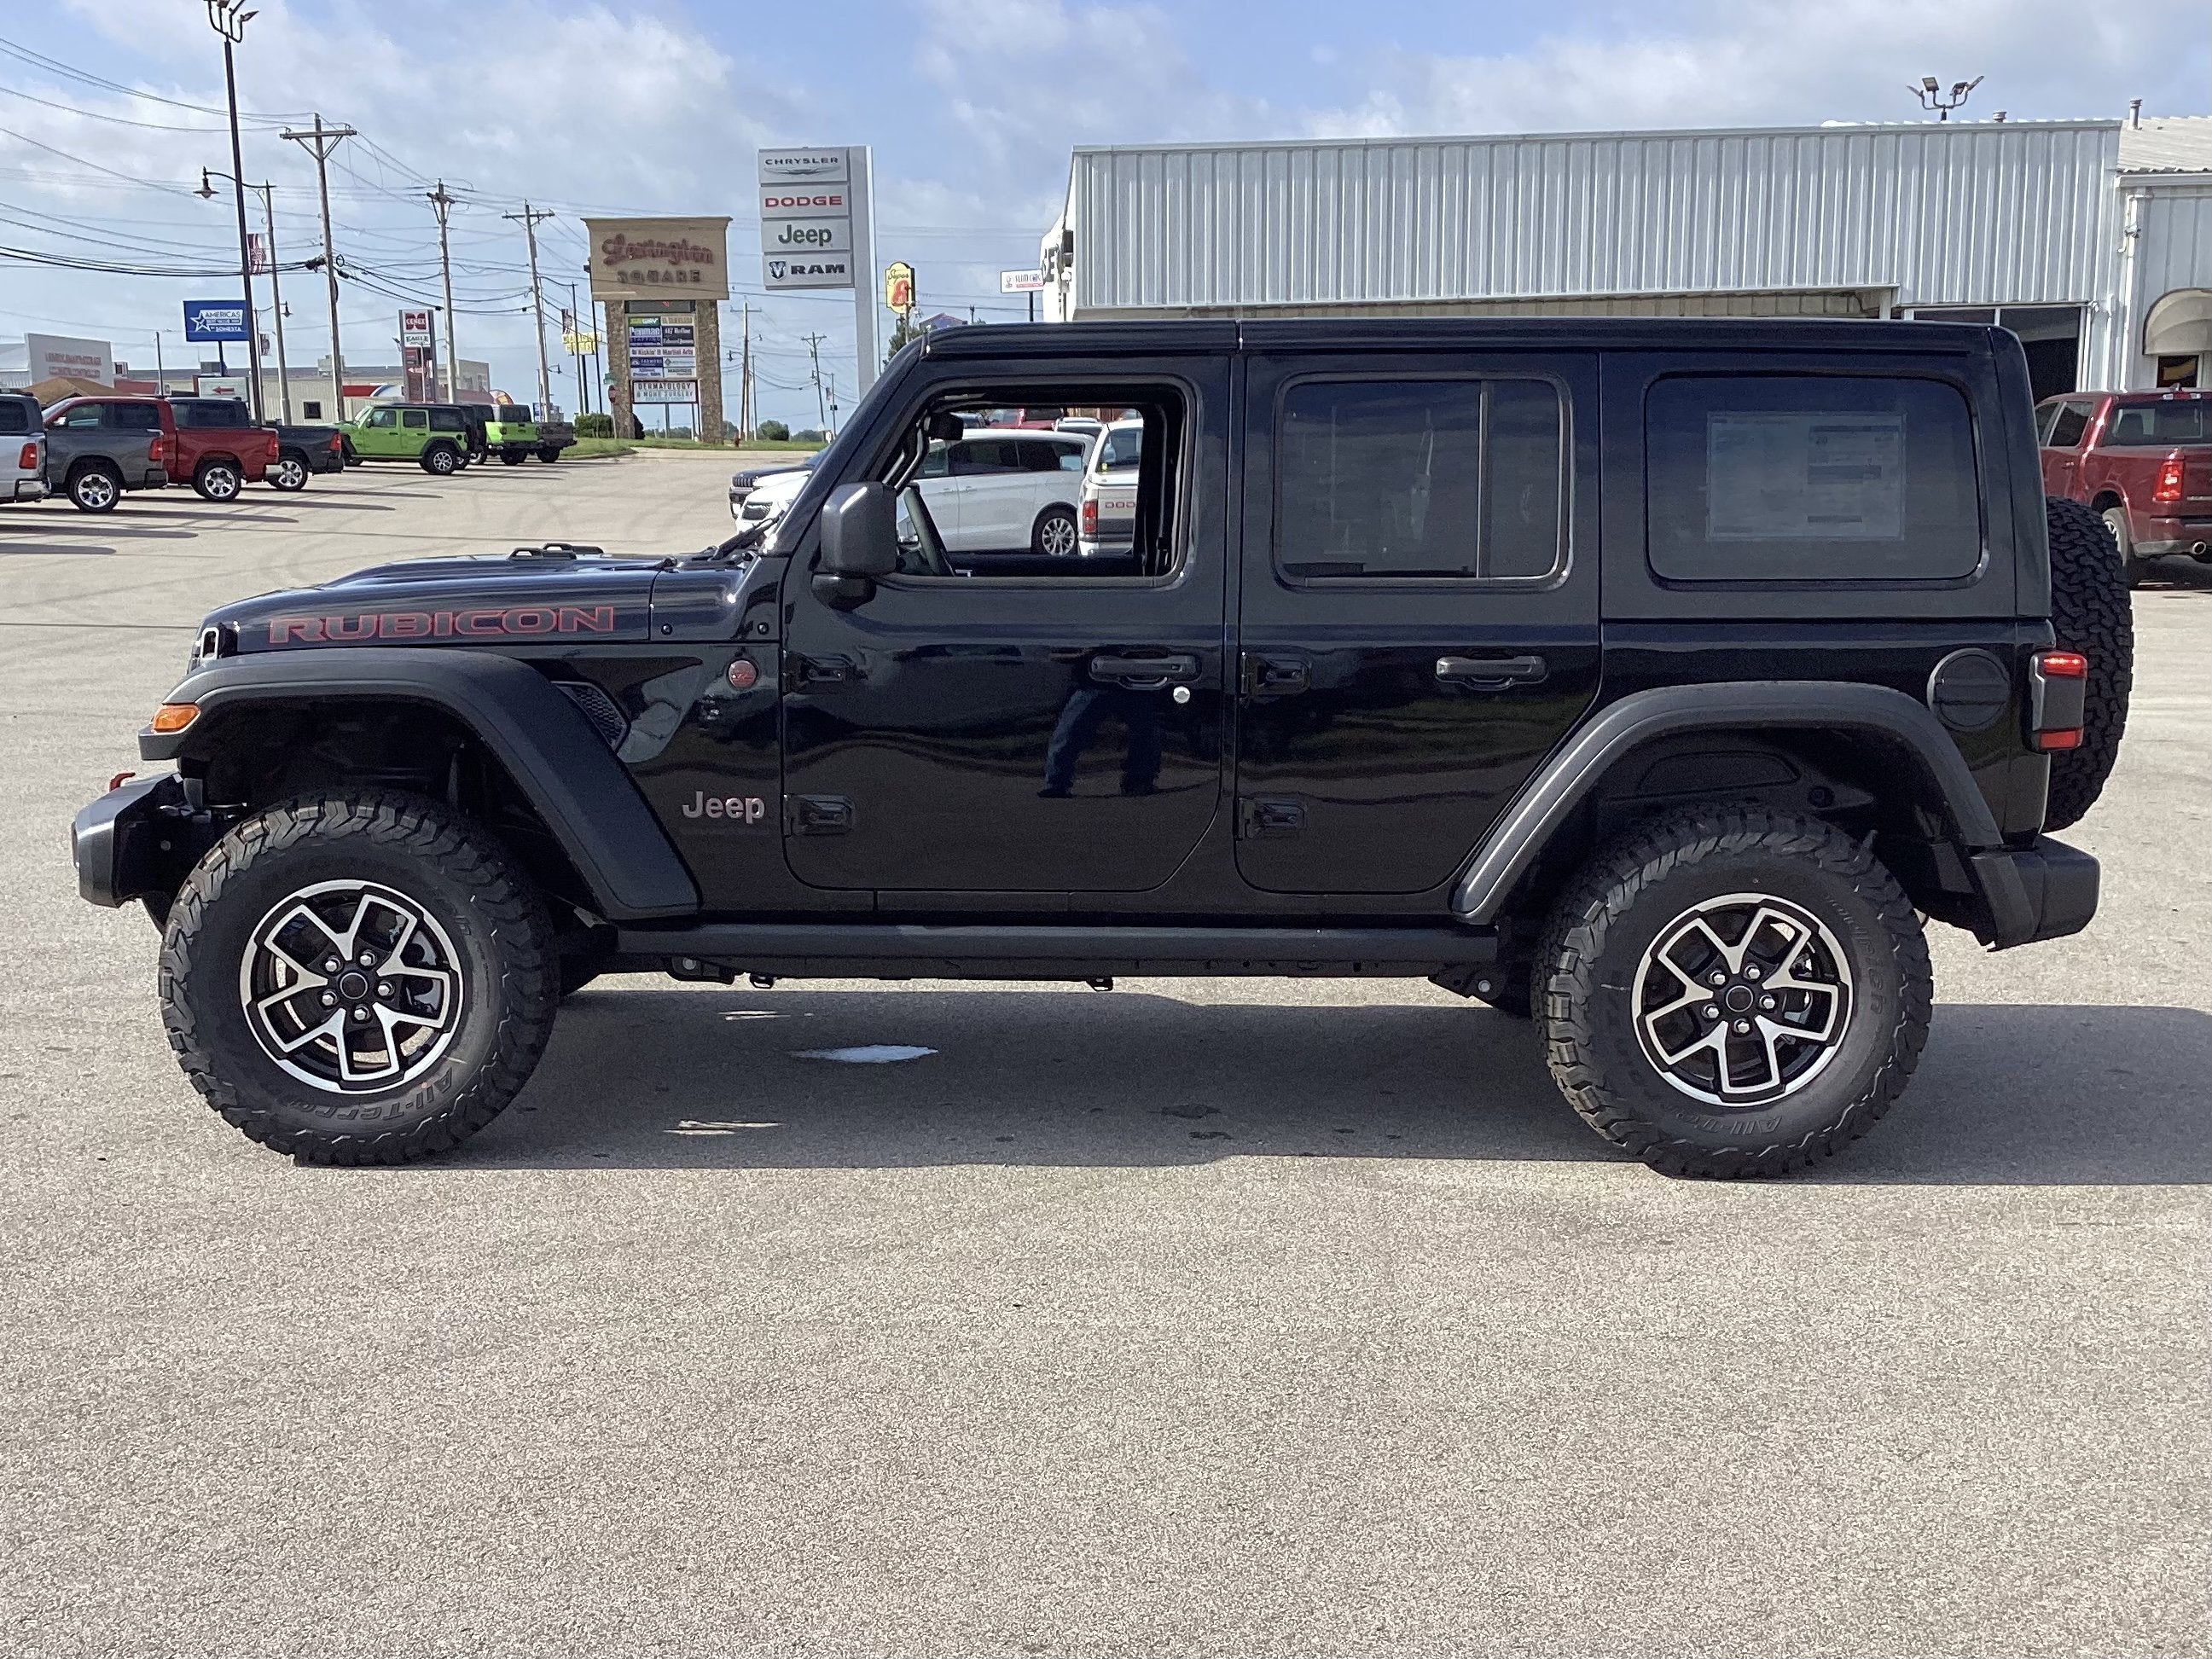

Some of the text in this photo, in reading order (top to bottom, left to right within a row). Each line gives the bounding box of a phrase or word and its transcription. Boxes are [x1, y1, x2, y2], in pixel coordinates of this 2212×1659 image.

[765, 157, 839, 165] CHRYSLER
[765, 196, 842, 207] DODGE
[778, 224, 833, 247] Jeep
[791, 264, 845, 275] RAM
[617, 270, 700, 283] SQUARE
[269, 606, 614, 644] RUBICON
[682, 791, 765, 824] Jeep
